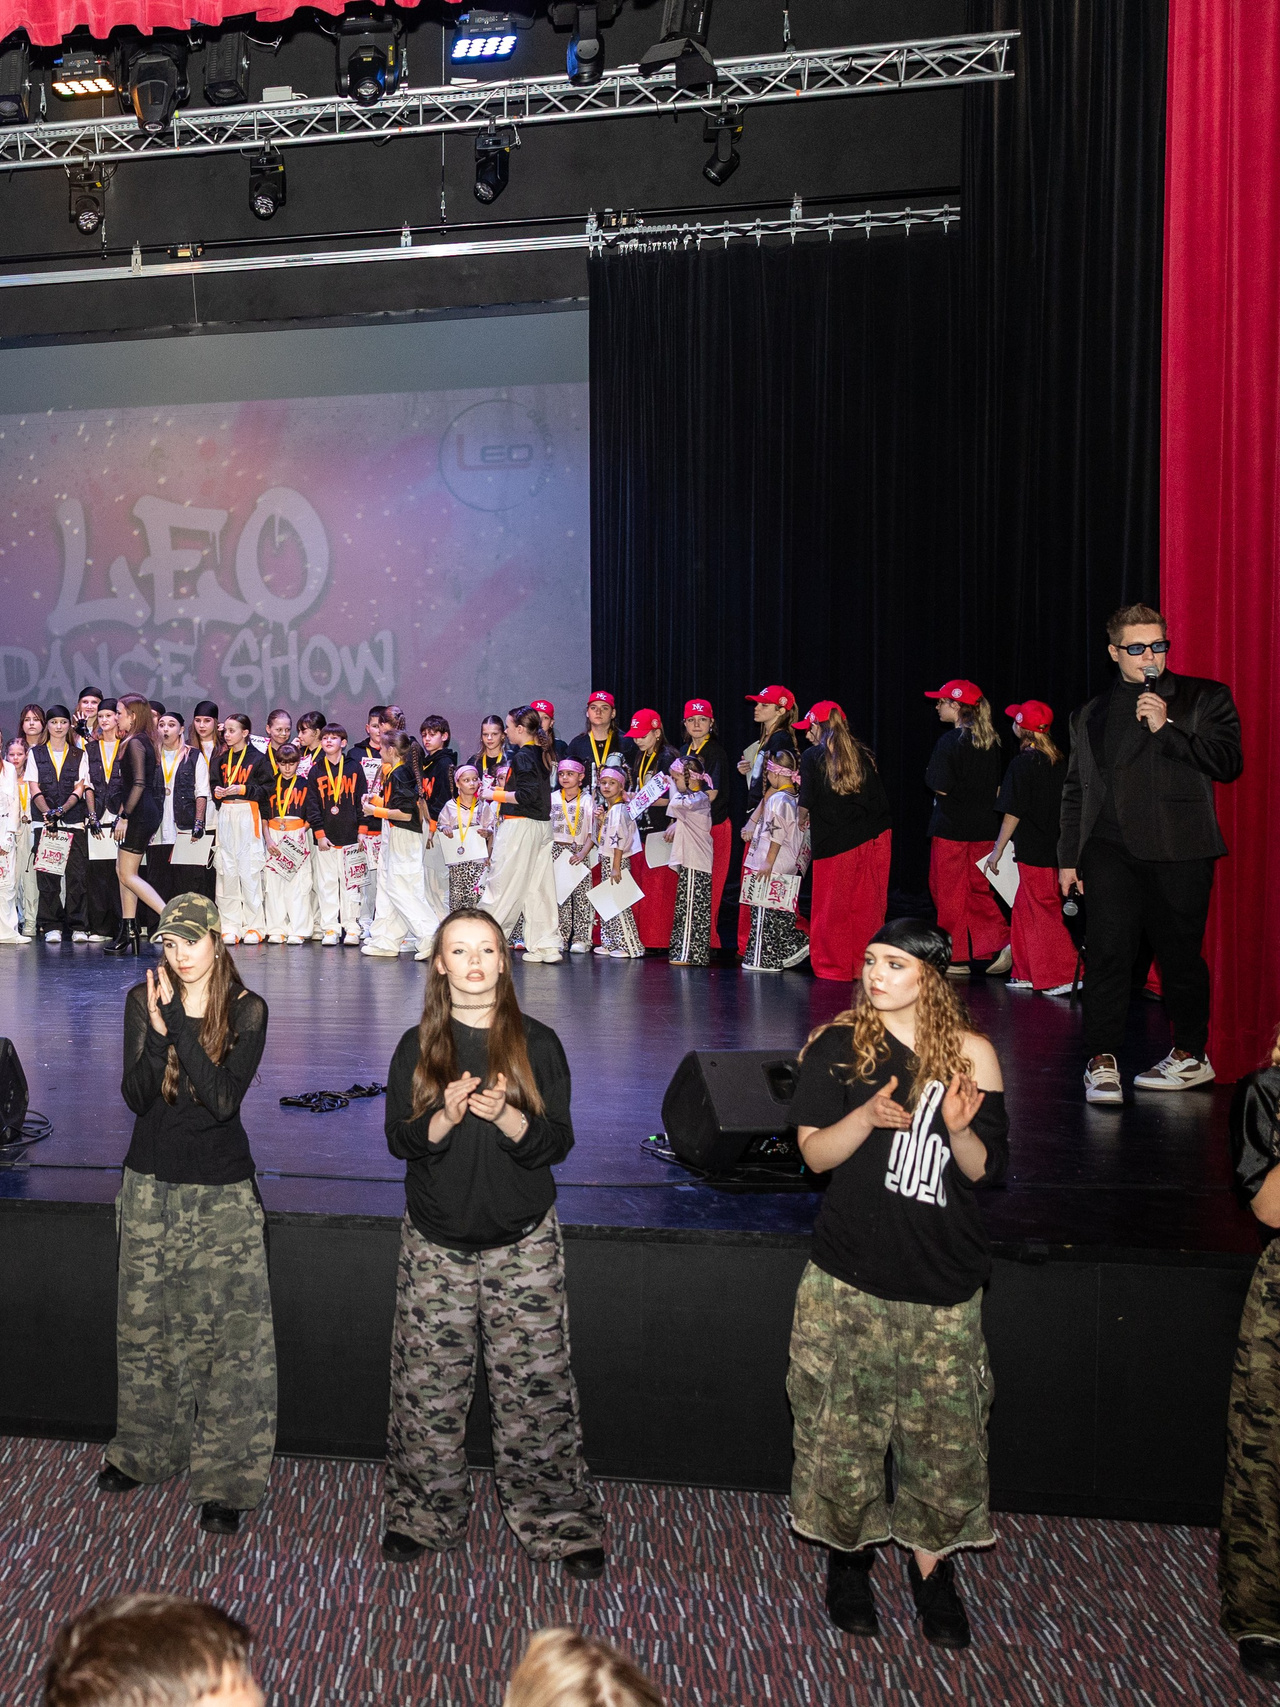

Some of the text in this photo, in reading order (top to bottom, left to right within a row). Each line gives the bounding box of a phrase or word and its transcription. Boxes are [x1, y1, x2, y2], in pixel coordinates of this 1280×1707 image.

[456, 434, 533, 471] LEO
[47, 486, 330, 636] LEO
[221, 629, 395, 702] SHOW
[317, 772, 358, 808] FLOW
